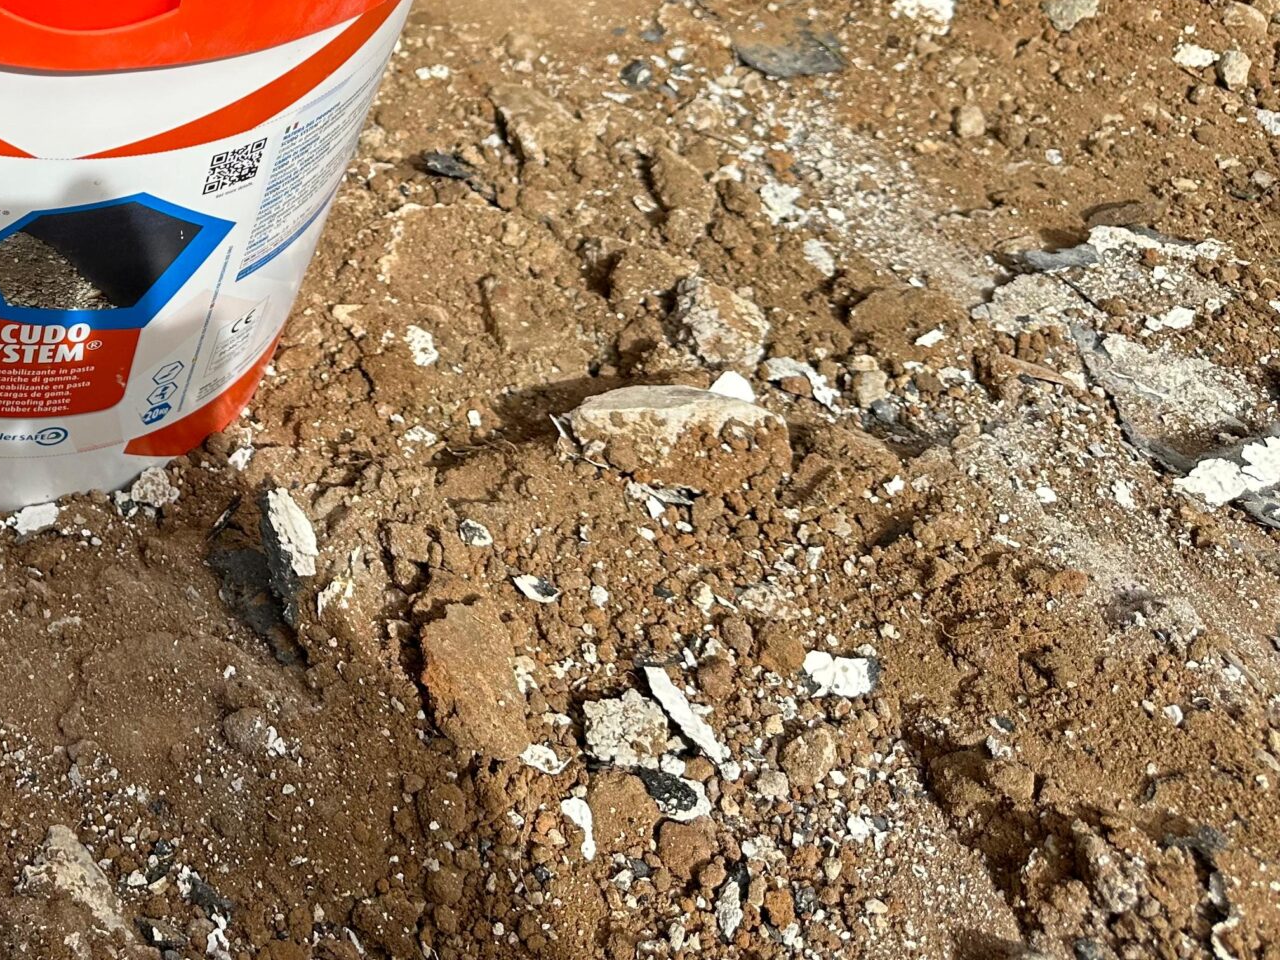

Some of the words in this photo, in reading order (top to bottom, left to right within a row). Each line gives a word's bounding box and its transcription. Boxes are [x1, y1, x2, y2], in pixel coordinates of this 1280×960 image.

[281, 135, 298, 147] SCUDO
[59, 367, 68, 375] in
[69, 365, 95, 375] pasta
[43, 375, 80, 384] gomma.
[66, 381, 91, 390] pasta
[0, 391, 28, 399] cargas
[44, 390, 72, 399] goma.
[46, 398, 71, 406] paste
[1, 405, 31, 413] rubber
[33, 404, 70, 413] charges.
